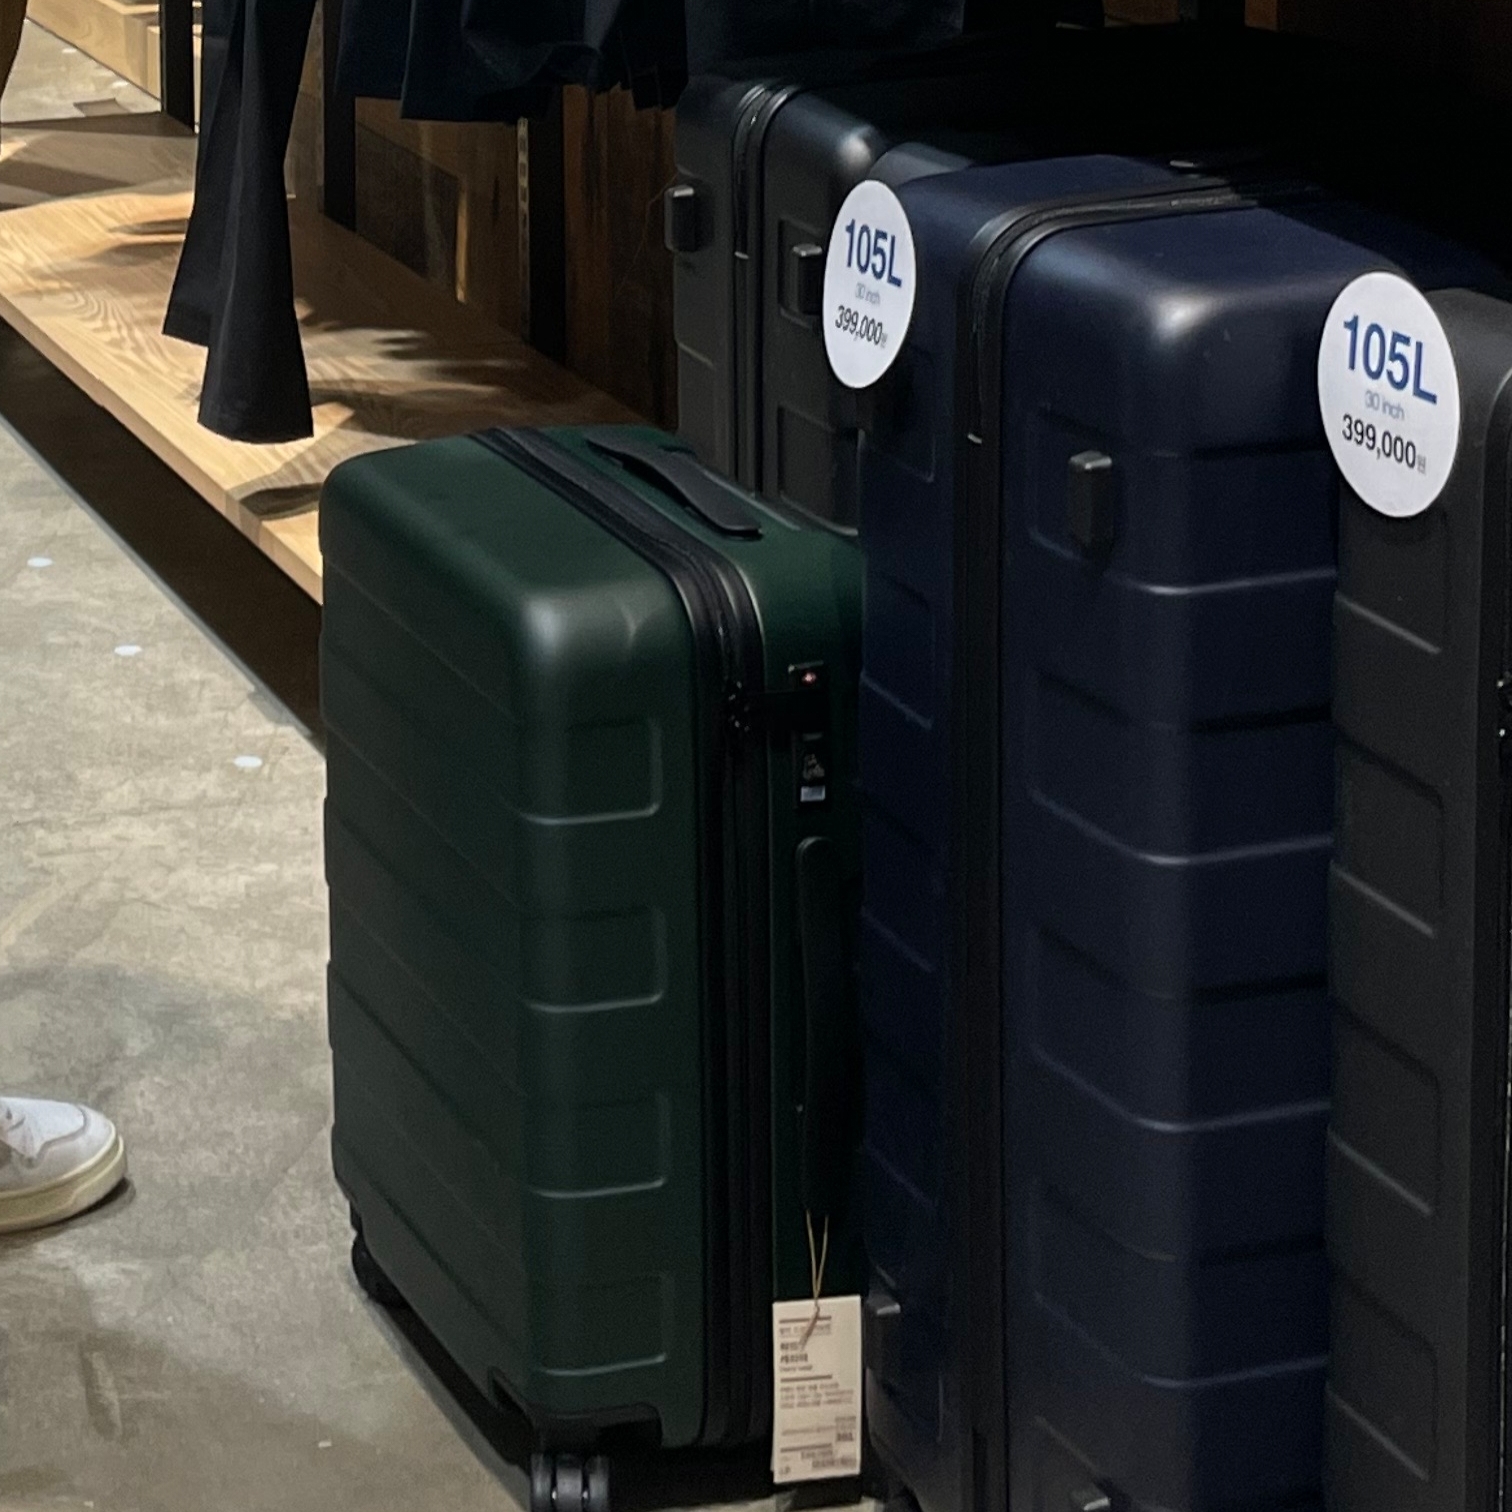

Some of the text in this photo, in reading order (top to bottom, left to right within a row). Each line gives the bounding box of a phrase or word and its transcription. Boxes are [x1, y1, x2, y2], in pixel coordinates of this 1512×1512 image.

[845, 219, 902, 287] 105L
[1343, 315, 1437, 405] 105L
[1365, 390, 1405, 421] 30 inch
